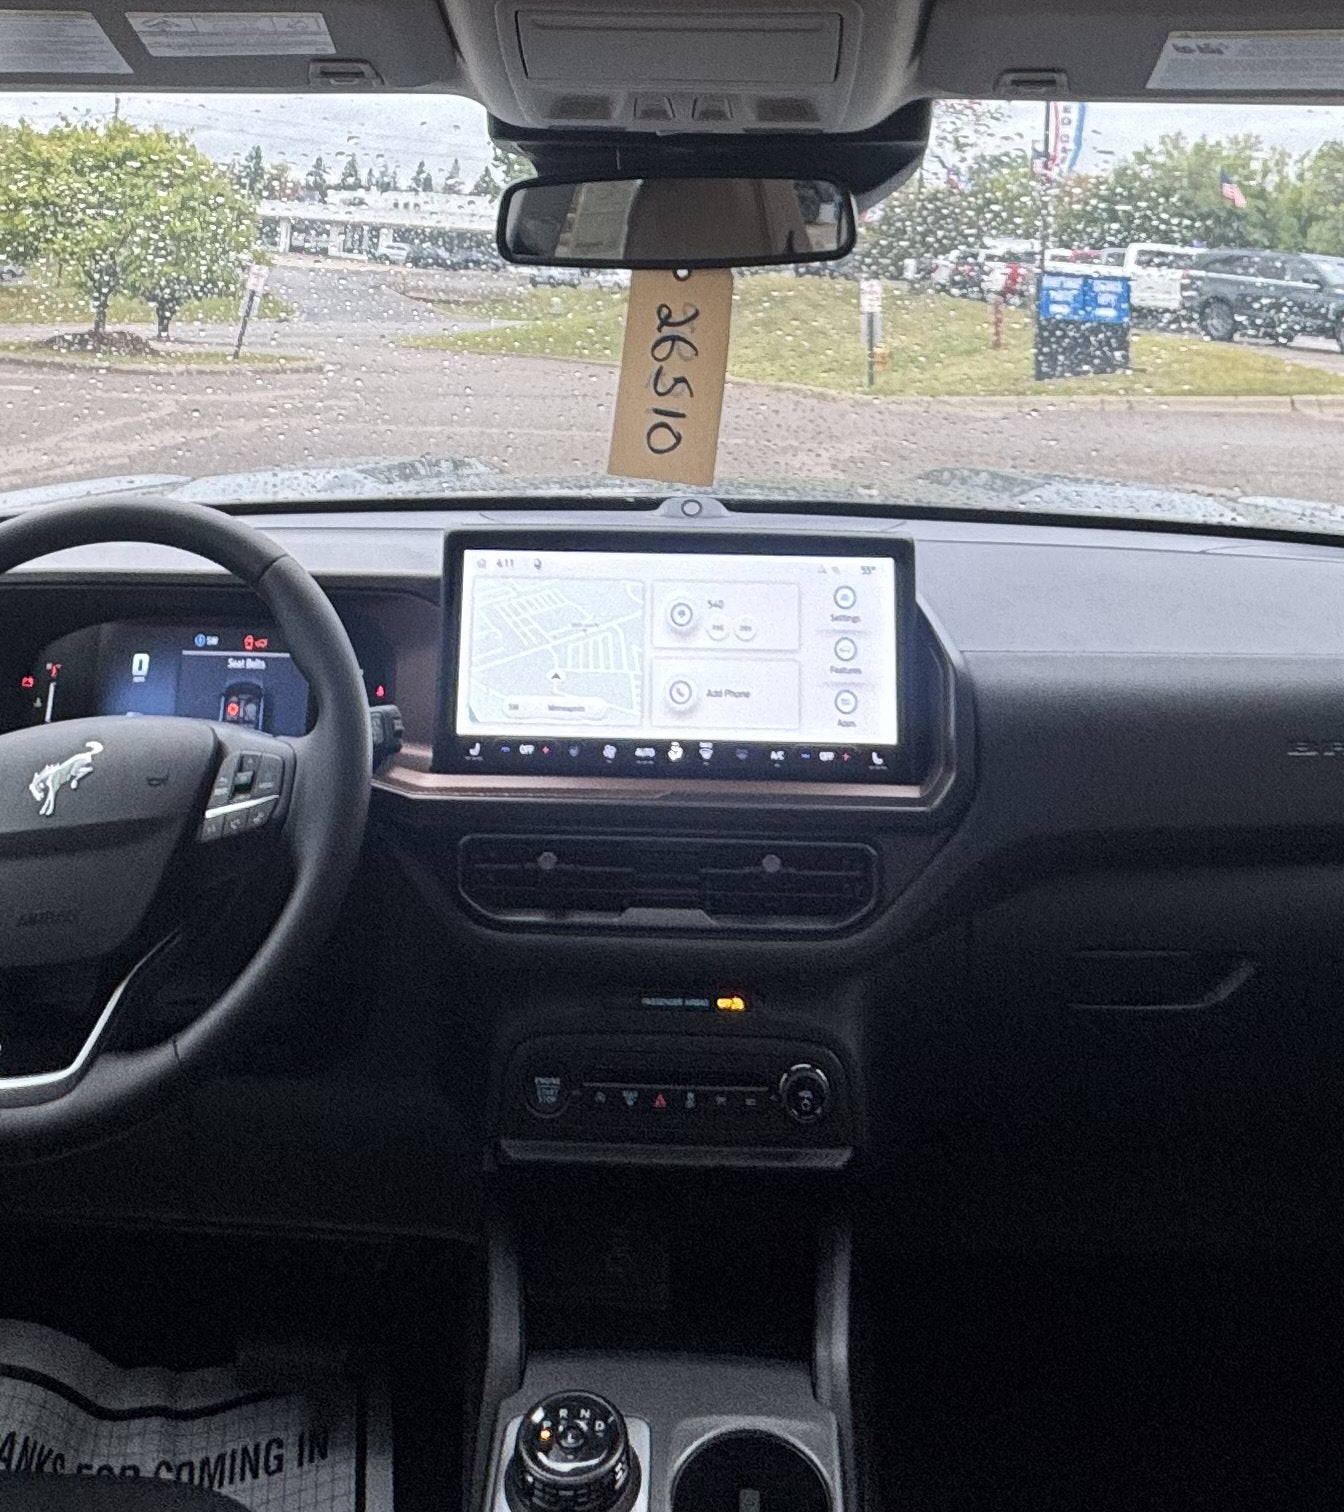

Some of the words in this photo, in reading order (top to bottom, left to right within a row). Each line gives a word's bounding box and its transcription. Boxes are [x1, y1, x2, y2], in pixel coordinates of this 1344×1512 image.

[646, 302, 701, 455] 26510
[706, 688, 723, 698] Add
[724, 688, 751, 699] Phone
[559, 1408, 568, 1418] R
[580, 1408, 591, 1418] N
[594, 1420, 605, 1431] D
[296, 1424, 330, 1468] IN
